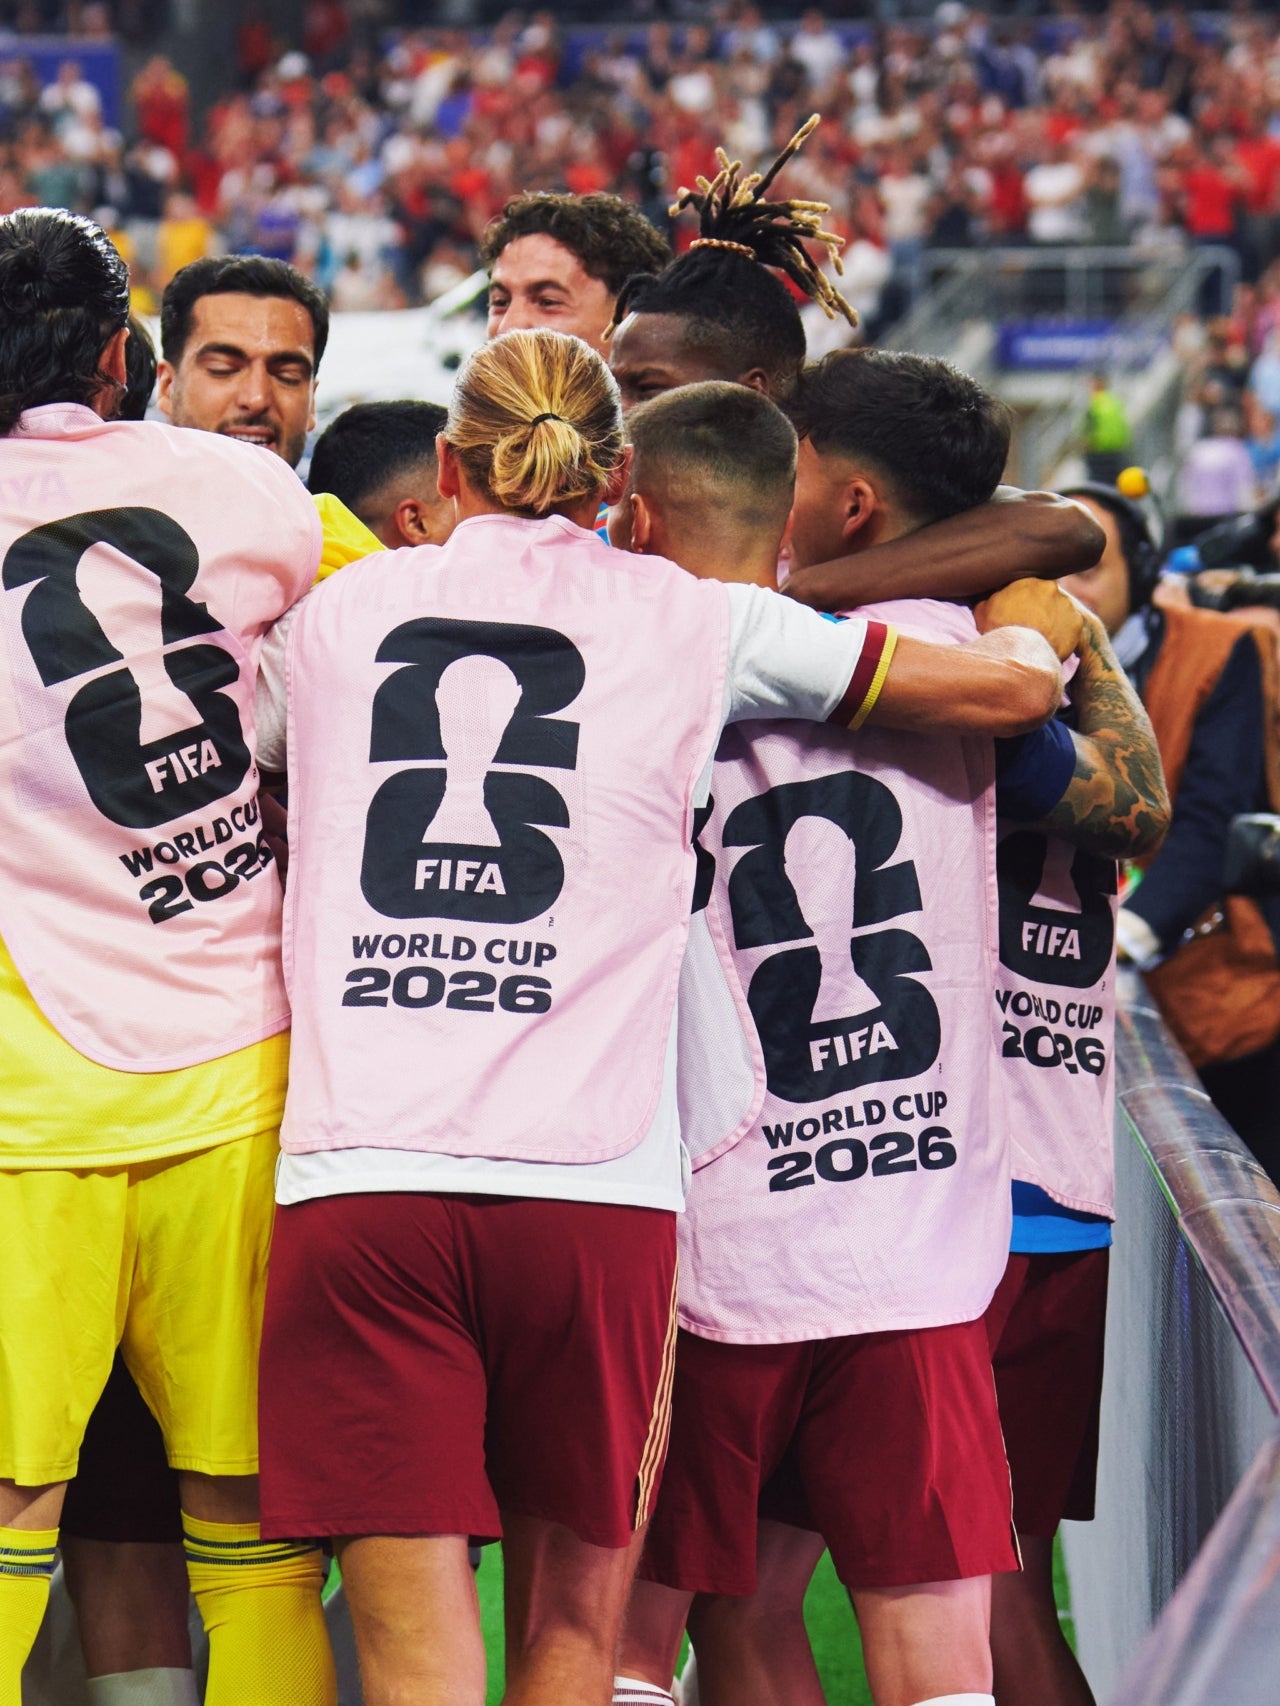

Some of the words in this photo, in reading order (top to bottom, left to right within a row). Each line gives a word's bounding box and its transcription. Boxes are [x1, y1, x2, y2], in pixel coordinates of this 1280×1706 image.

[144, 739, 222, 793] FIFA
[118, 817, 233, 878] WORLD
[230, 794, 260, 833] CU
[414, 859, 507, 895] FIFA
[352, 933, 477, 961] WORLD
[484, 938, 557, 967] CUP
[1022, 921, 1081, 960] FIFA
[341, 966, 552, 1014] 2026
[1065, 1002, 1103, 1030] CUP
[809, 1021, 899, 1072] FIFA
[1002, 1020, 1106, 1077] 2026
[761, 1099, 886, 1149] WORLD
[892, 1090, 947, 1121] CUP
[767, 1125, 957, 1193] 2026
